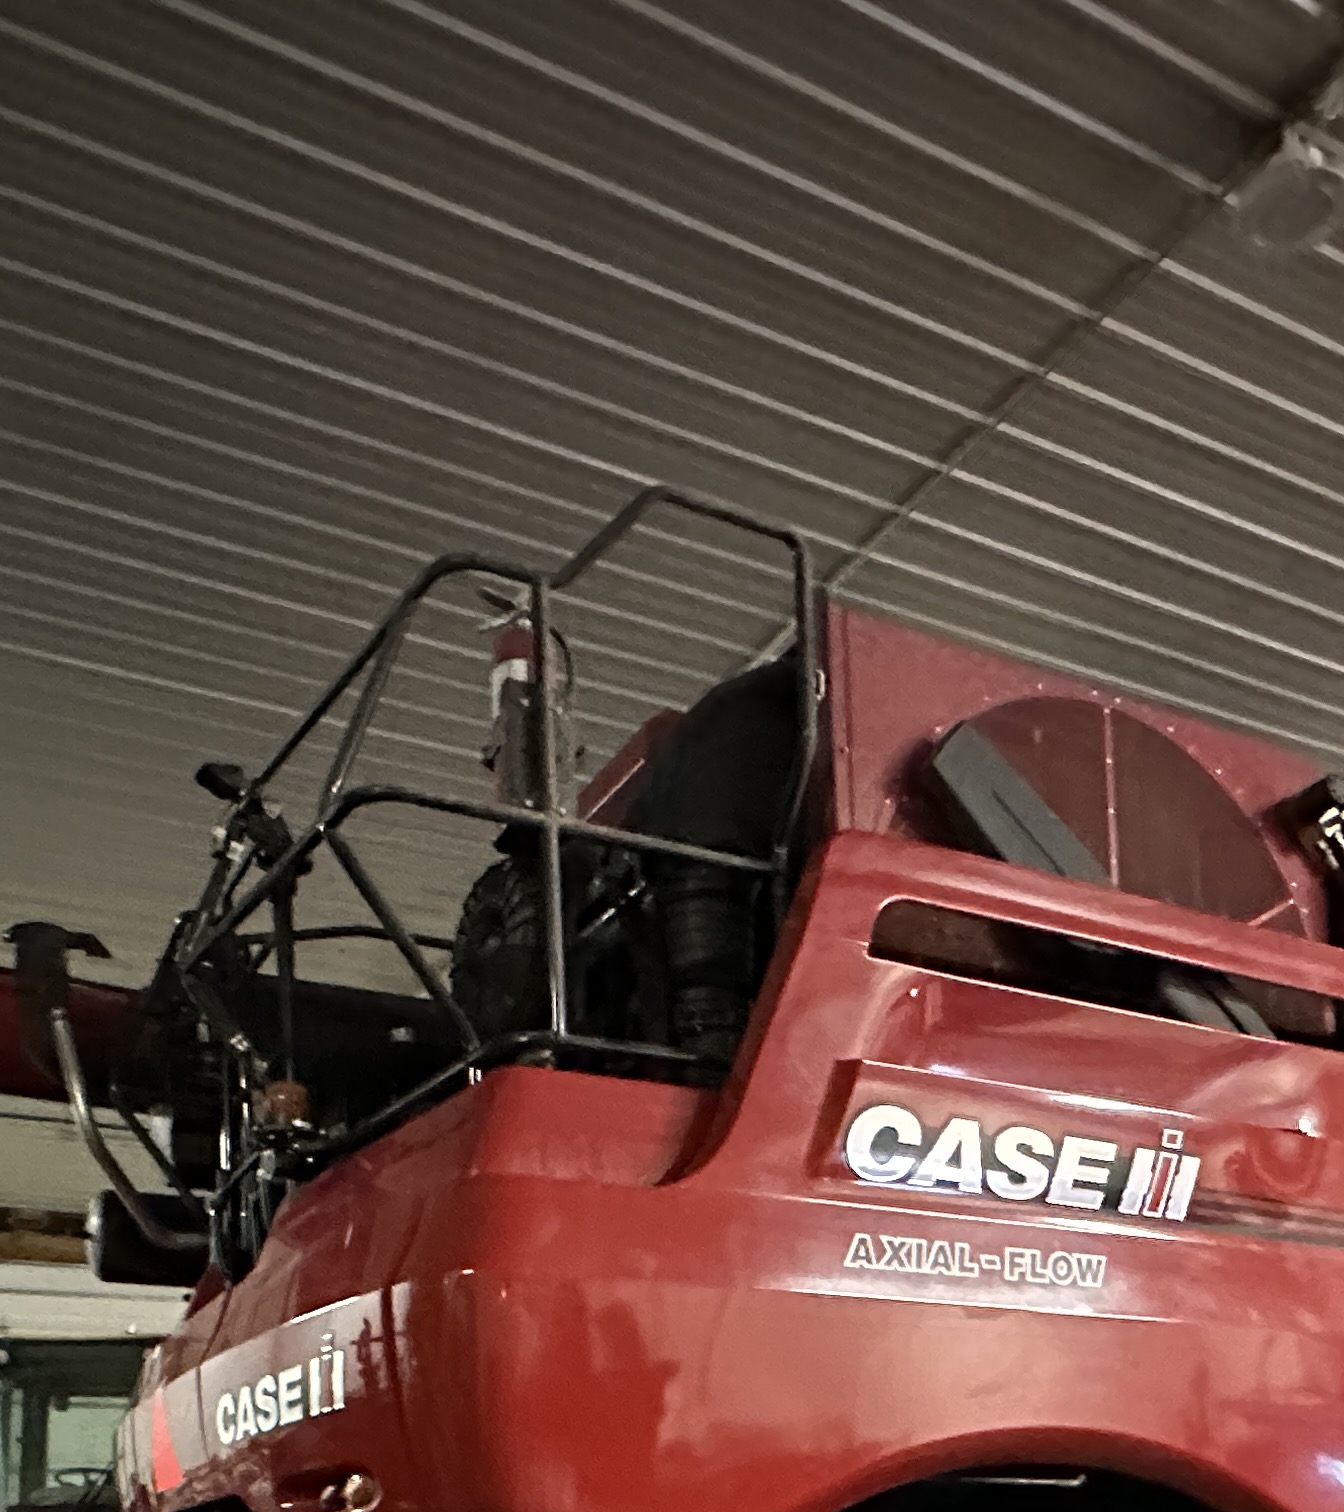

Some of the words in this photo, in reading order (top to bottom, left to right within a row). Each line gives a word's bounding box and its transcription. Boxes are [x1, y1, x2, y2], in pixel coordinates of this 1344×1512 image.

[844, 1103, 1119, 1213] CASE
[844, 1233, 1107, 1288] AXIAL-FLOW
[216, 1364, 304, 1445] CASE
